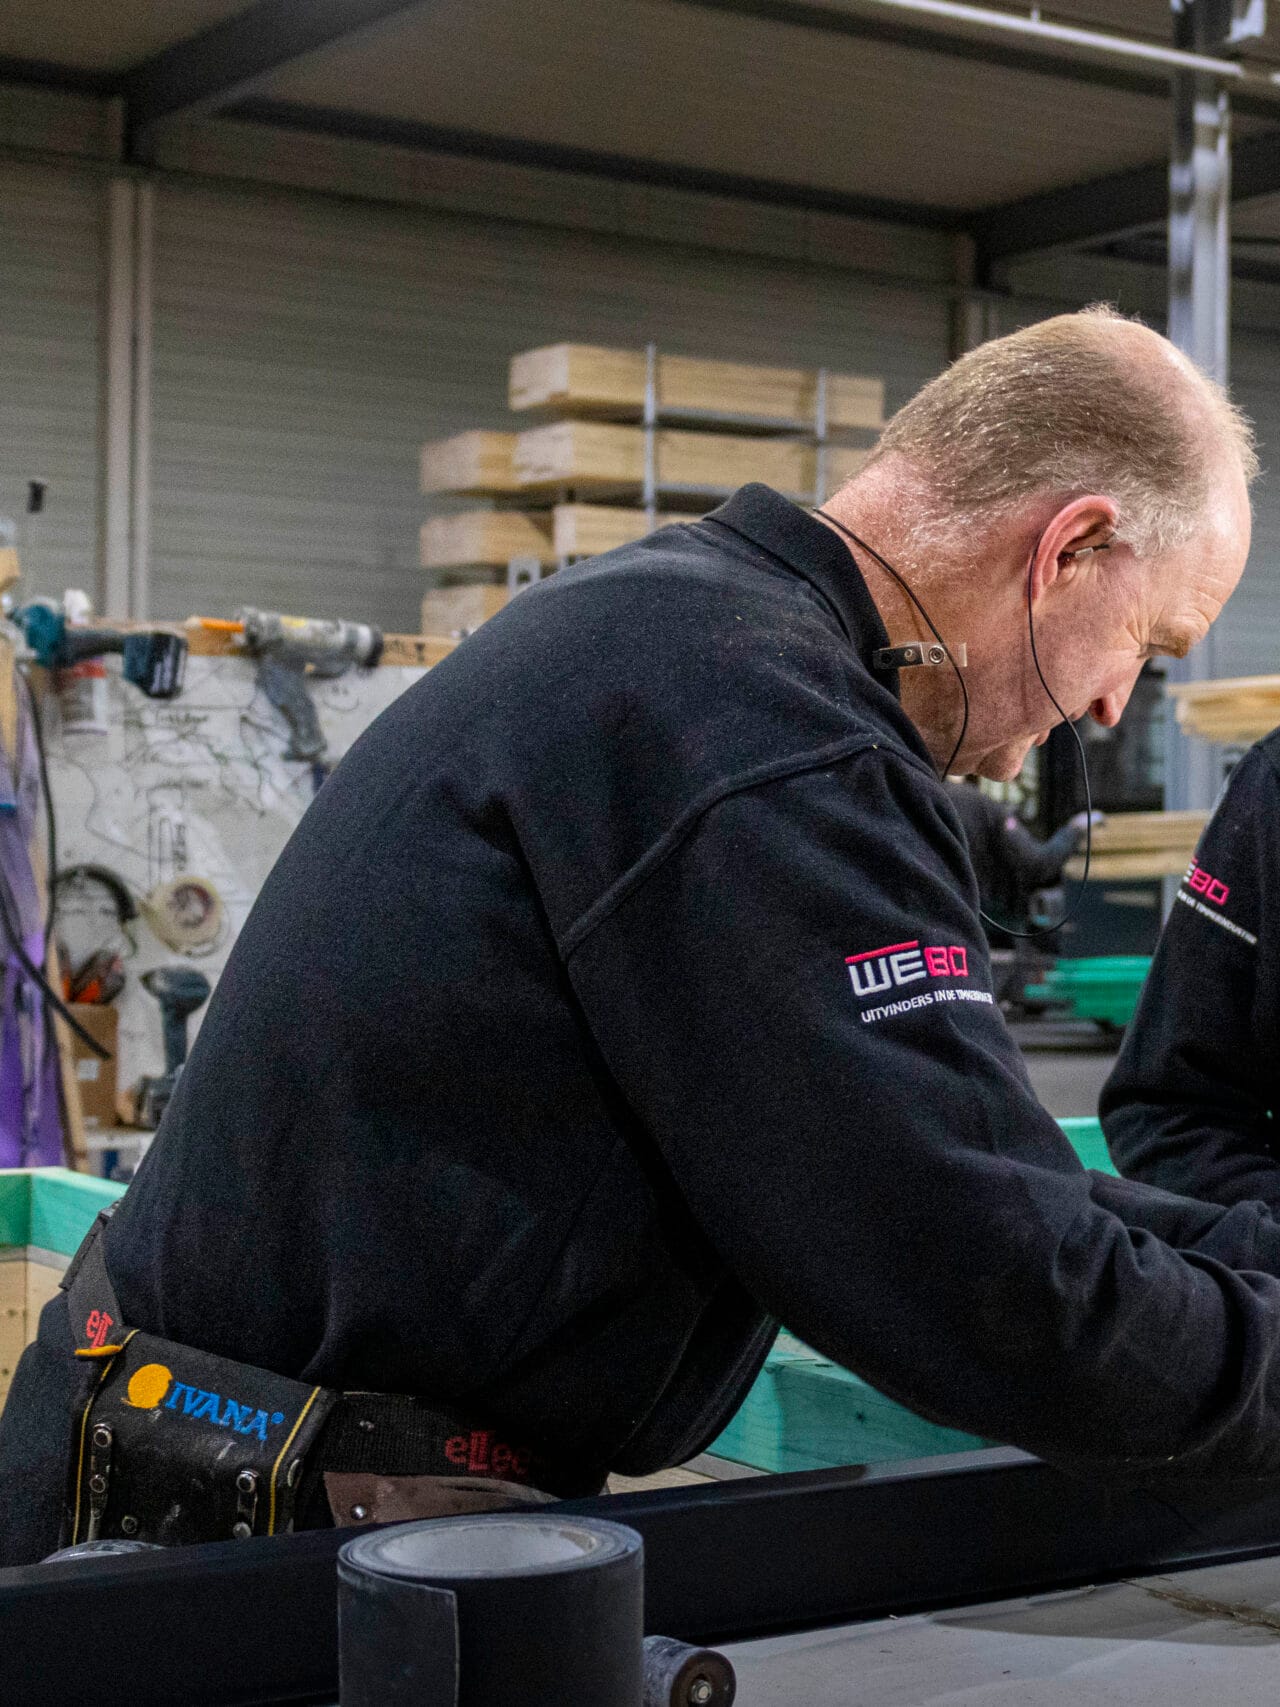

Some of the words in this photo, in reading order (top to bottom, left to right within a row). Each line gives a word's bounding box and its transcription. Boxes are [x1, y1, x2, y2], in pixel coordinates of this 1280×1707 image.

[848, 946, 969, 996] WEBO
[861, 992, 933, 1023] UITVINDERS
[934, 989, 947, 1002] IN
[946, 990, 957, 1001] DE
[165, 1381, 270, 1442] IVANA
